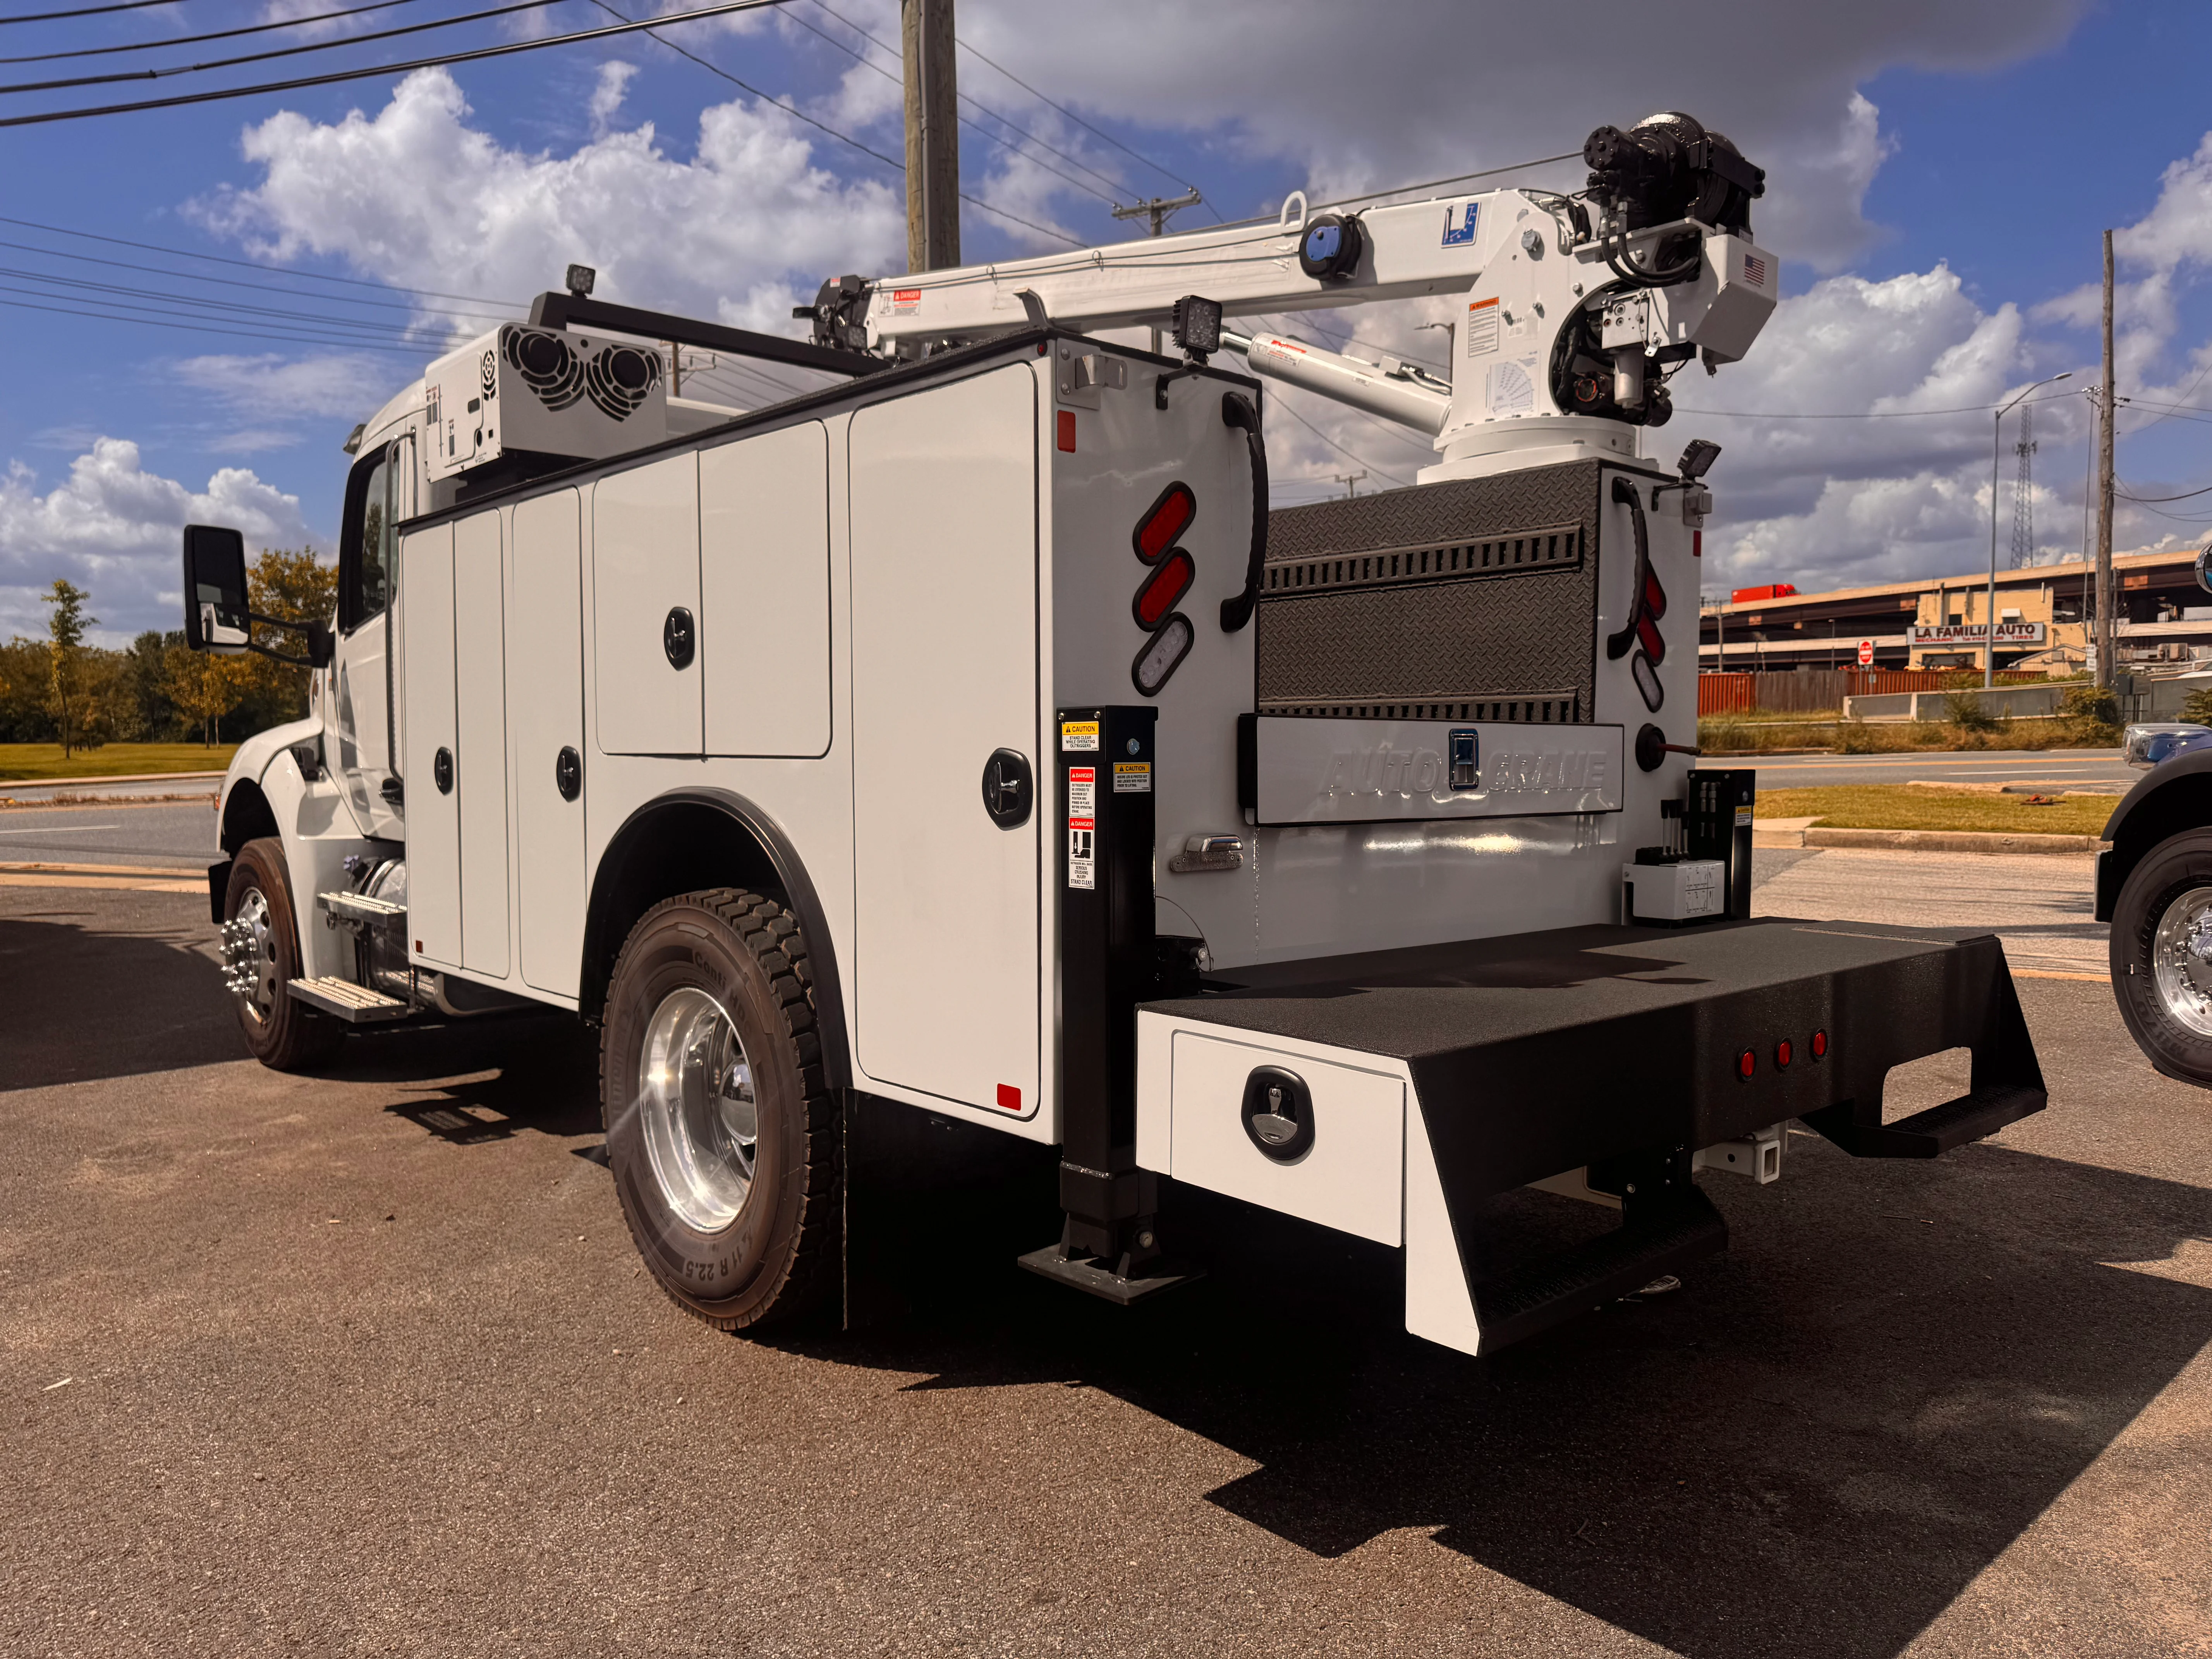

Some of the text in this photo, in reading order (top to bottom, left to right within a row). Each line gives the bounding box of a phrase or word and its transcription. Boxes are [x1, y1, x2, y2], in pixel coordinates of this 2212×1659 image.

[1915, 629, 1932, 637] LA
[1996, 625, 2035, 635] AUTO
[1319, 749, 1606, 795] AUTO CRANE
[694, 951, 726, 992] Conti
[720, 1257, 729, 1277] R
[732, 1246, 742, 1269] 11
[685, 1260, 714, 1281] 22.5
